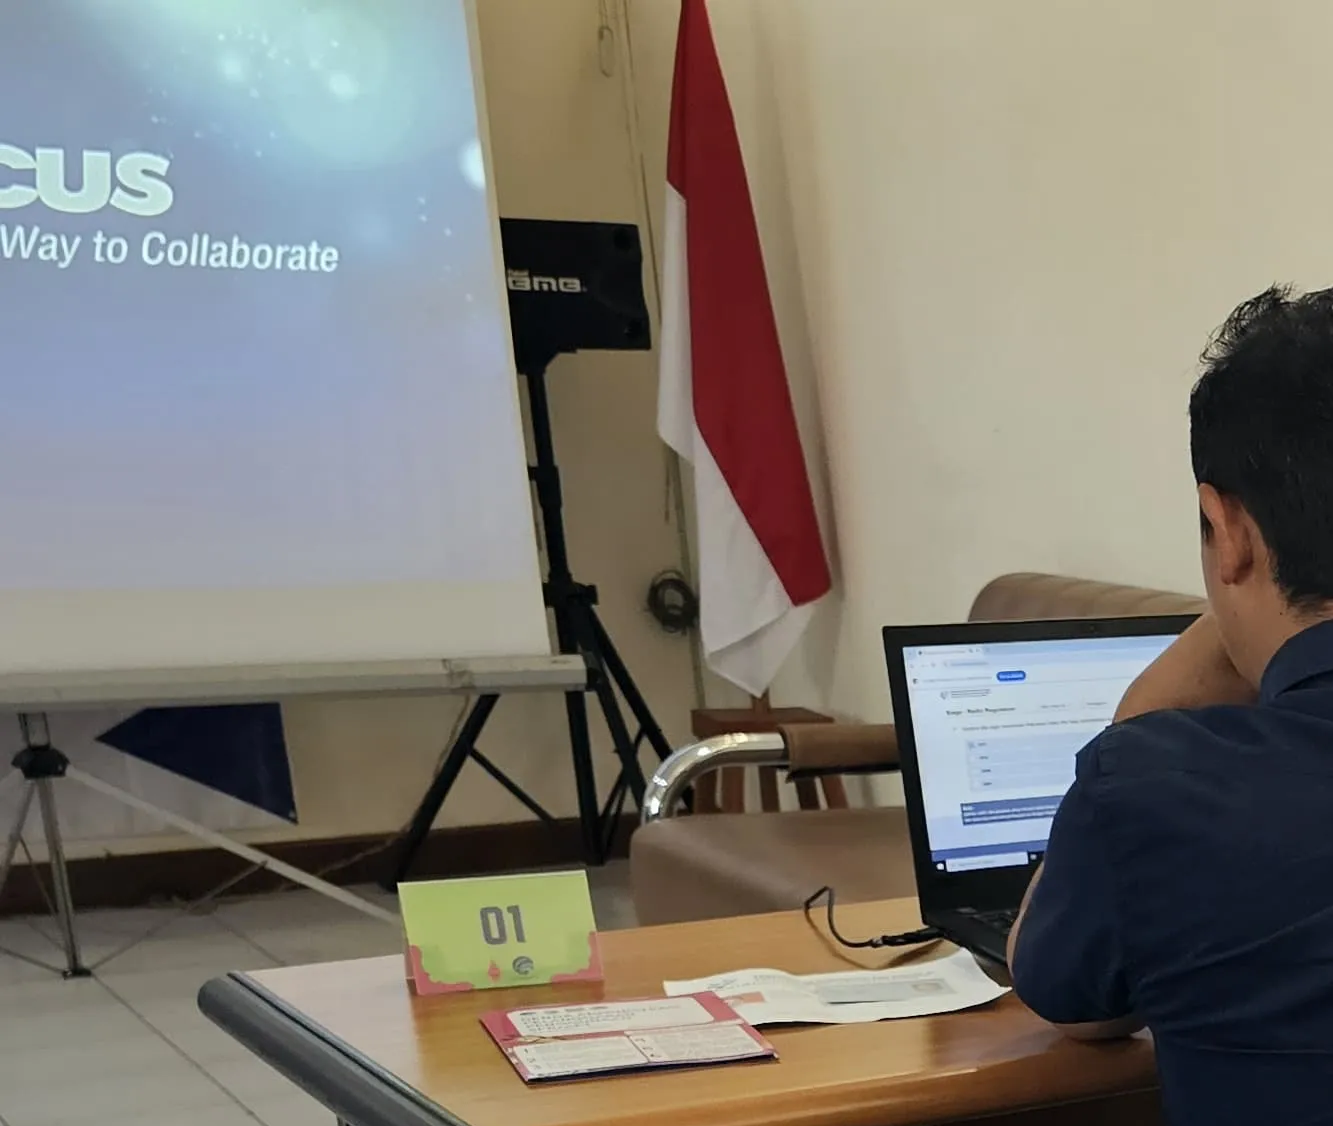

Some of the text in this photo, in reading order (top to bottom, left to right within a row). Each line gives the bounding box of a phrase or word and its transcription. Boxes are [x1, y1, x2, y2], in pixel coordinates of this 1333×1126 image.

[0, 223, 340, 273] Way to Collaborate
[479, 905, 527, 946] 01
